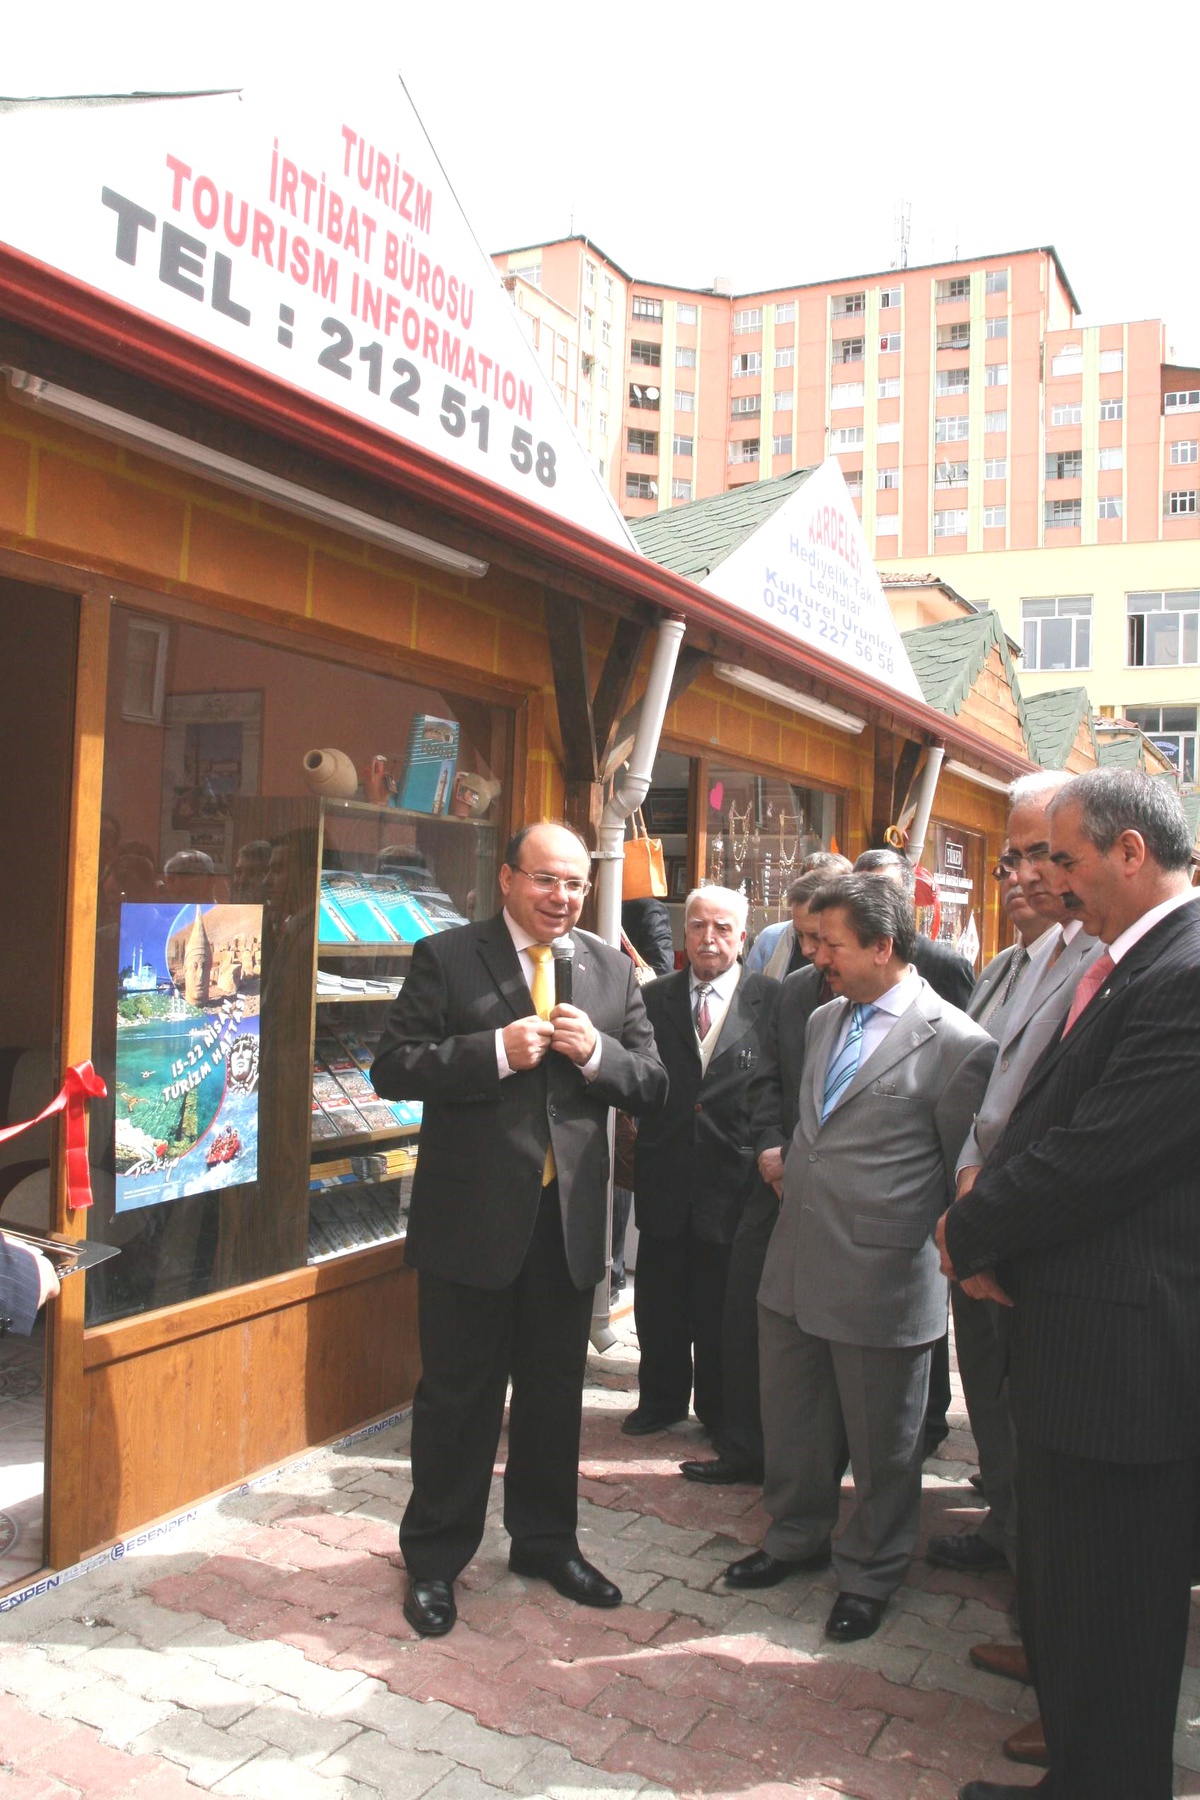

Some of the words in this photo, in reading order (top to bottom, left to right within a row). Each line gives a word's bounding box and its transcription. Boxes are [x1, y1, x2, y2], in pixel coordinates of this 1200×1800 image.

[269, 136, 377, 265] İRTİBAT
[383, 229, 474, 331] BÜROSU
[341, 123, 432, 236] TURİZM
[101, 185, 251, 327] TEL
[317, 316, 421, 417] 212
[439, 383, 490, 454] 51
[510, 425, 557, 489] 58
[165, 153, 339, 304] TOURISM
[350, 271, 533, 422] INFORMATION
[762, 587, 812, 630] 0543
[818, 619, 849, 648] 227
[854, 641, 873, 663] 56
[877, 652, 894, 675] 58
[809, 569, 862, 617] Levhalar
[162, 1060, 212, 1103] TURİZM
[211, 993, 246, 1066] HAFTASI
[171, 1044, 204, 1079] 15-22
[203, 998, 233, 1049] NİSAN
[126, 1510, 197, 1552] ESENPEN
